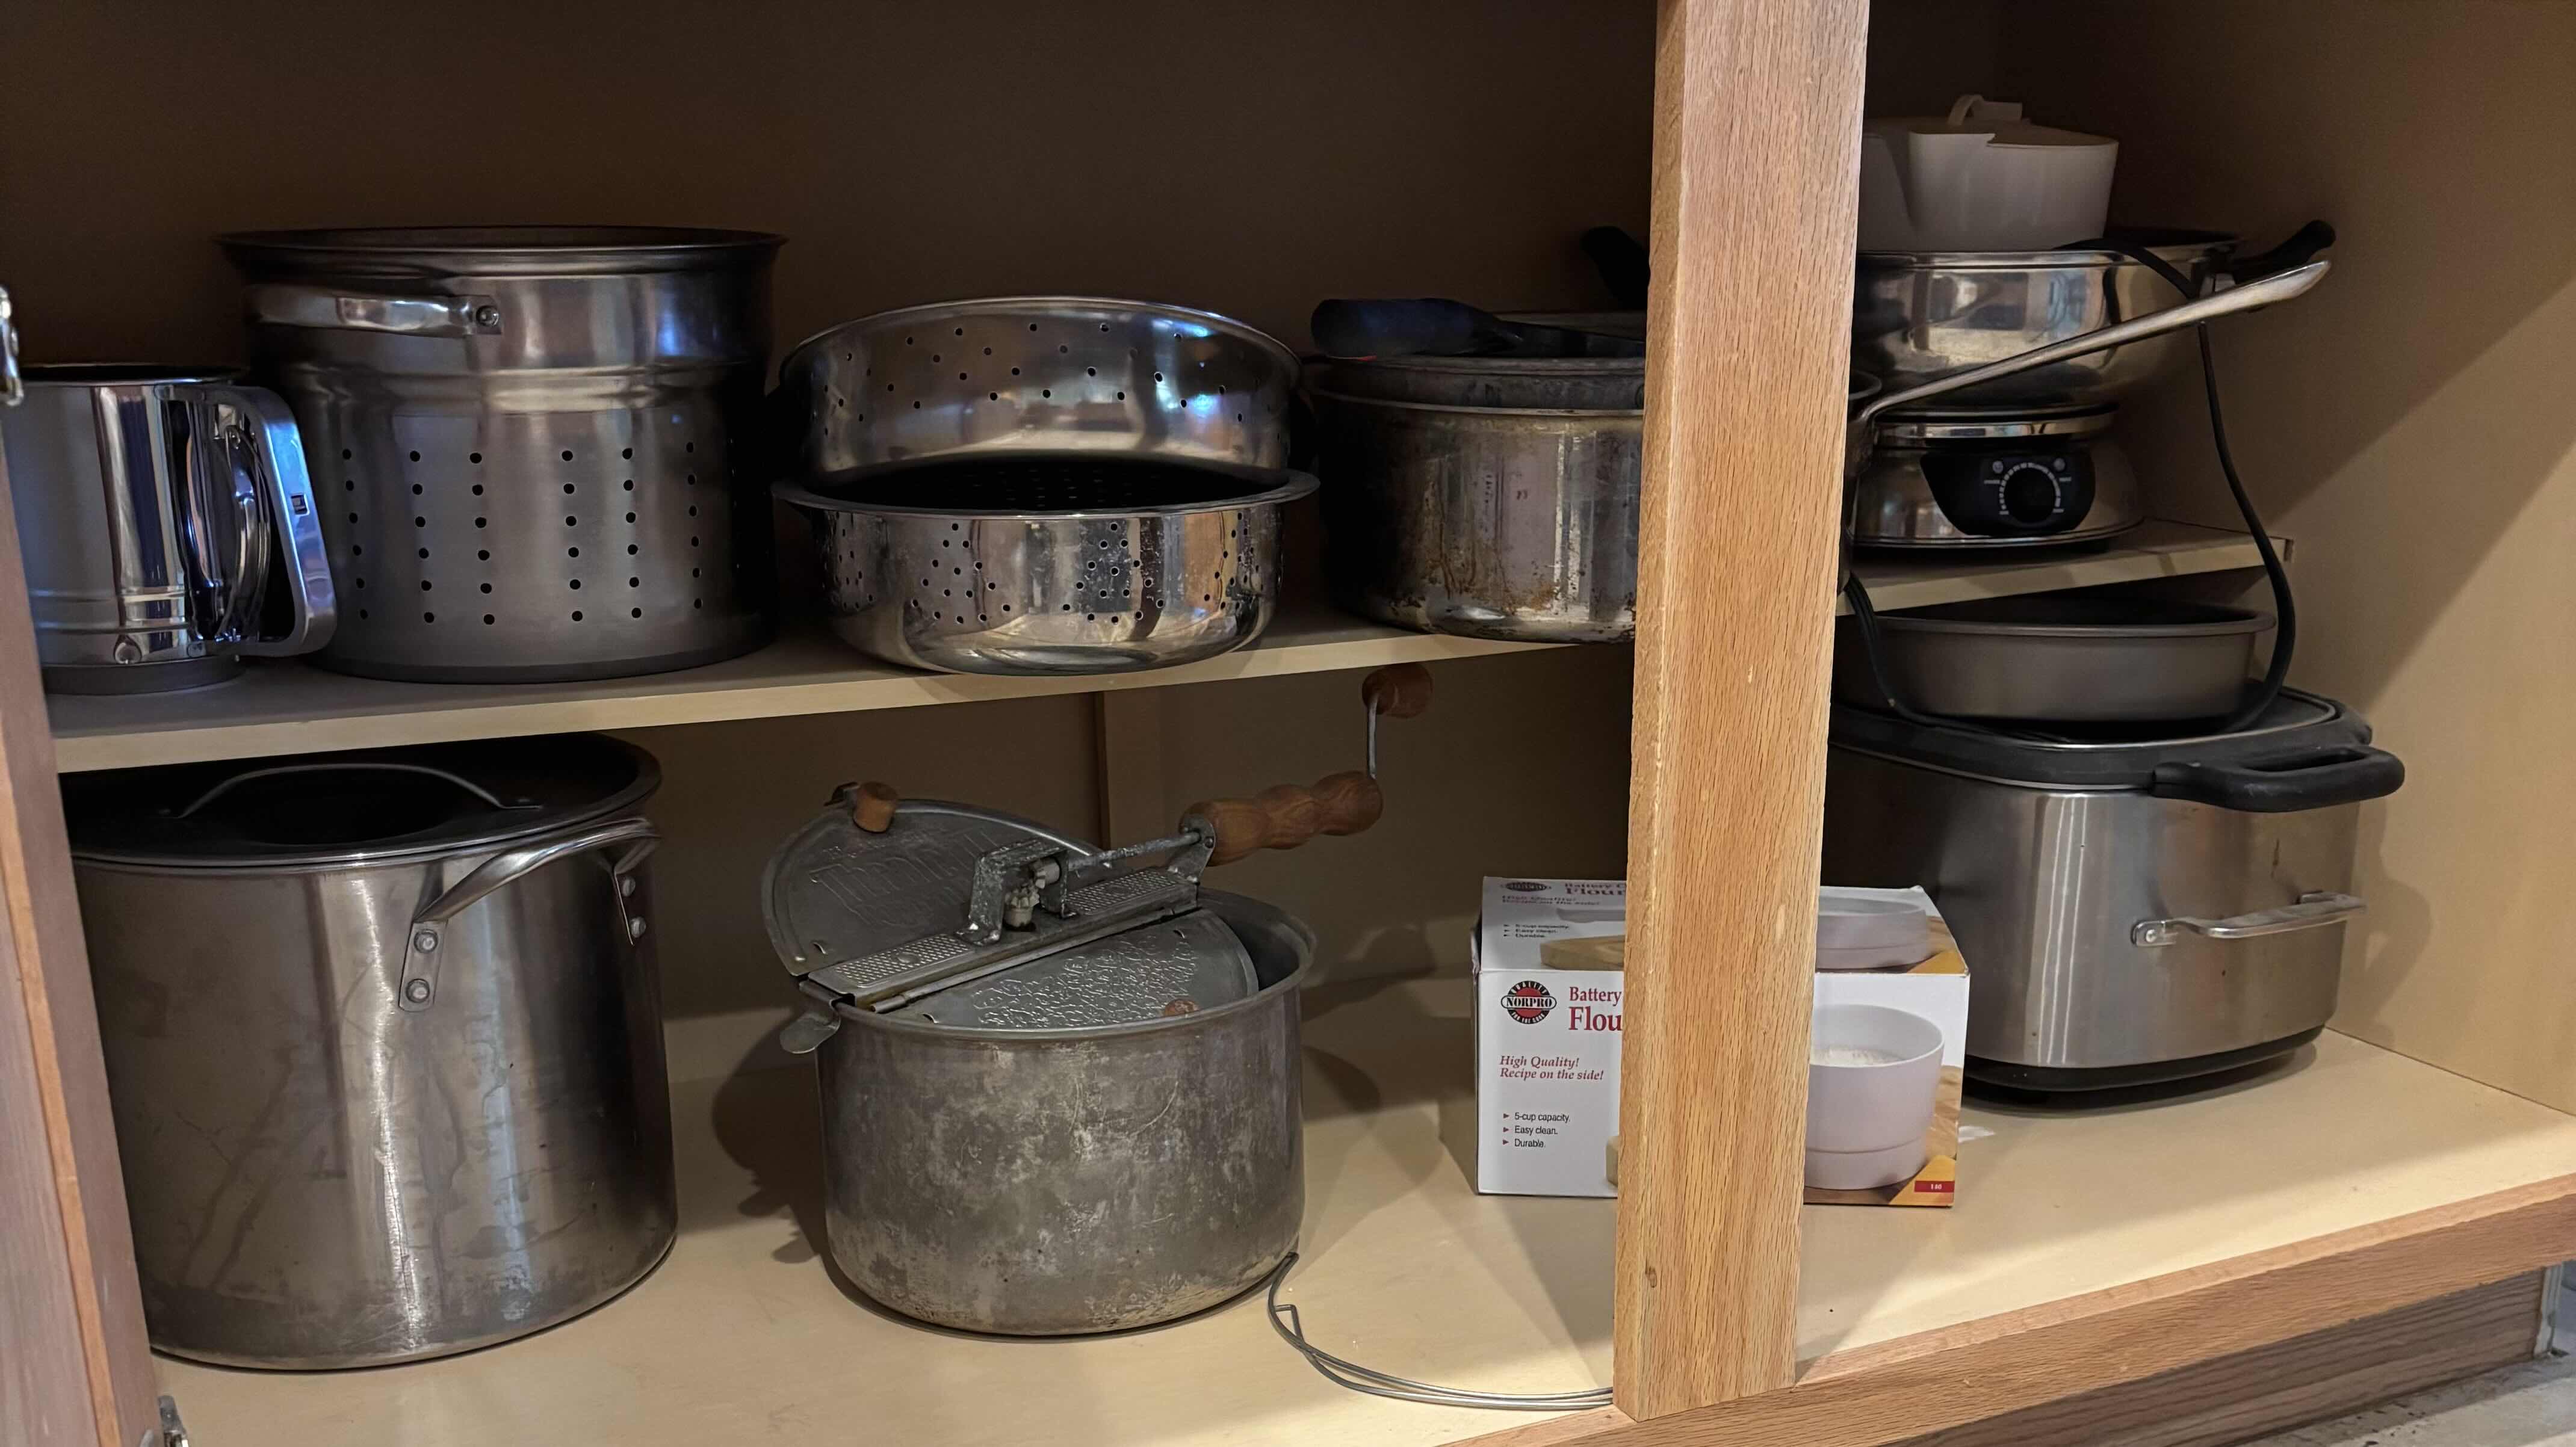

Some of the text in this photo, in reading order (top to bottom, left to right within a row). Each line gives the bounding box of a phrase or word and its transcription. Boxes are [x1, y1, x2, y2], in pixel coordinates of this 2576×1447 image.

[1506, 997, 1552, 1007] NORPRO
[1569, 986, 1622, 1007] Battery
[1500, 1055, 1579, 1069] High Quality!
[1500, 1068, 1537, 1081] Recipe
[1556, 1069, 1576, 1079] the
[1577, 1070, 1604, 1081] side!
[1514, 1112, 1570, 1124] 5-cup capacity.
[1514, 1125, 1558, 1136] Easy clean.
[1514, 1138, 1546, 1148] Durable.
